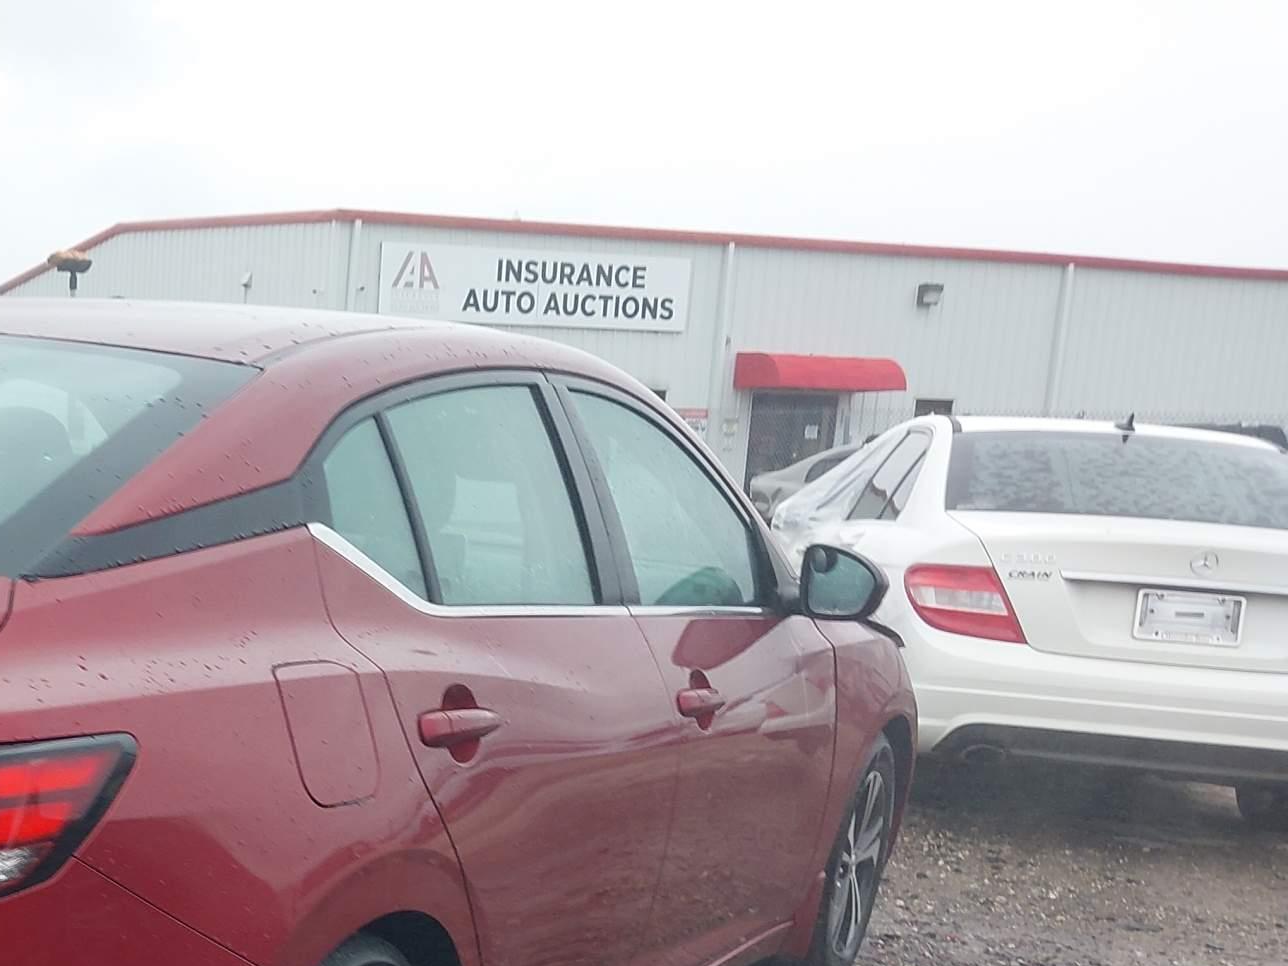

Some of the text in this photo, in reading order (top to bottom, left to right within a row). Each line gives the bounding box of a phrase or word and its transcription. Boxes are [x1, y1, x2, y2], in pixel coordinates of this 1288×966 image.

[496, 258, 647, 288] INSURANCE
[462, 288, 536, 315] AUTO
[543, 292, 674, 320] AUCTIONS
